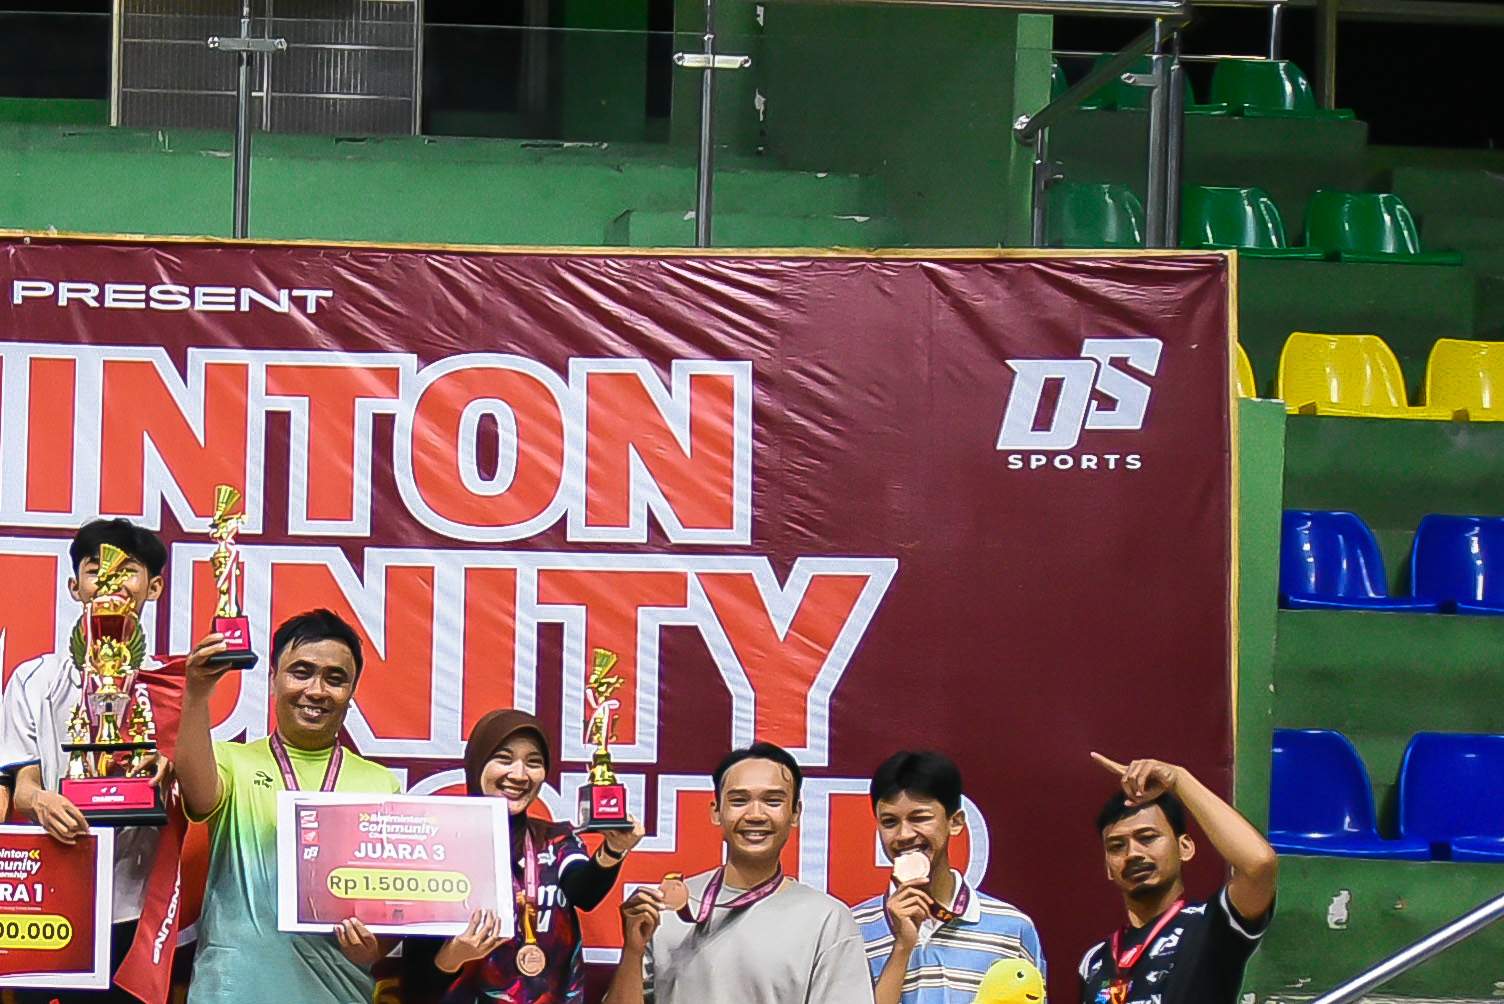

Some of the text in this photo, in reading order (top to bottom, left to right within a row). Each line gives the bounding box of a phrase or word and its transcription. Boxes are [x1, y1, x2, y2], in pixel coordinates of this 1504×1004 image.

[12, 280, 333, 314] PRESENT
[995, 338, 1164, 451] DS
[1007, 454, 1142, 470] SPORTS
[358, 821, 439, 838] Community
[353, 842, 446, 861] JUARA 3
[34, 883, 43, 902] 1
[330, 875, 469, 896] Rp 1.500.000
